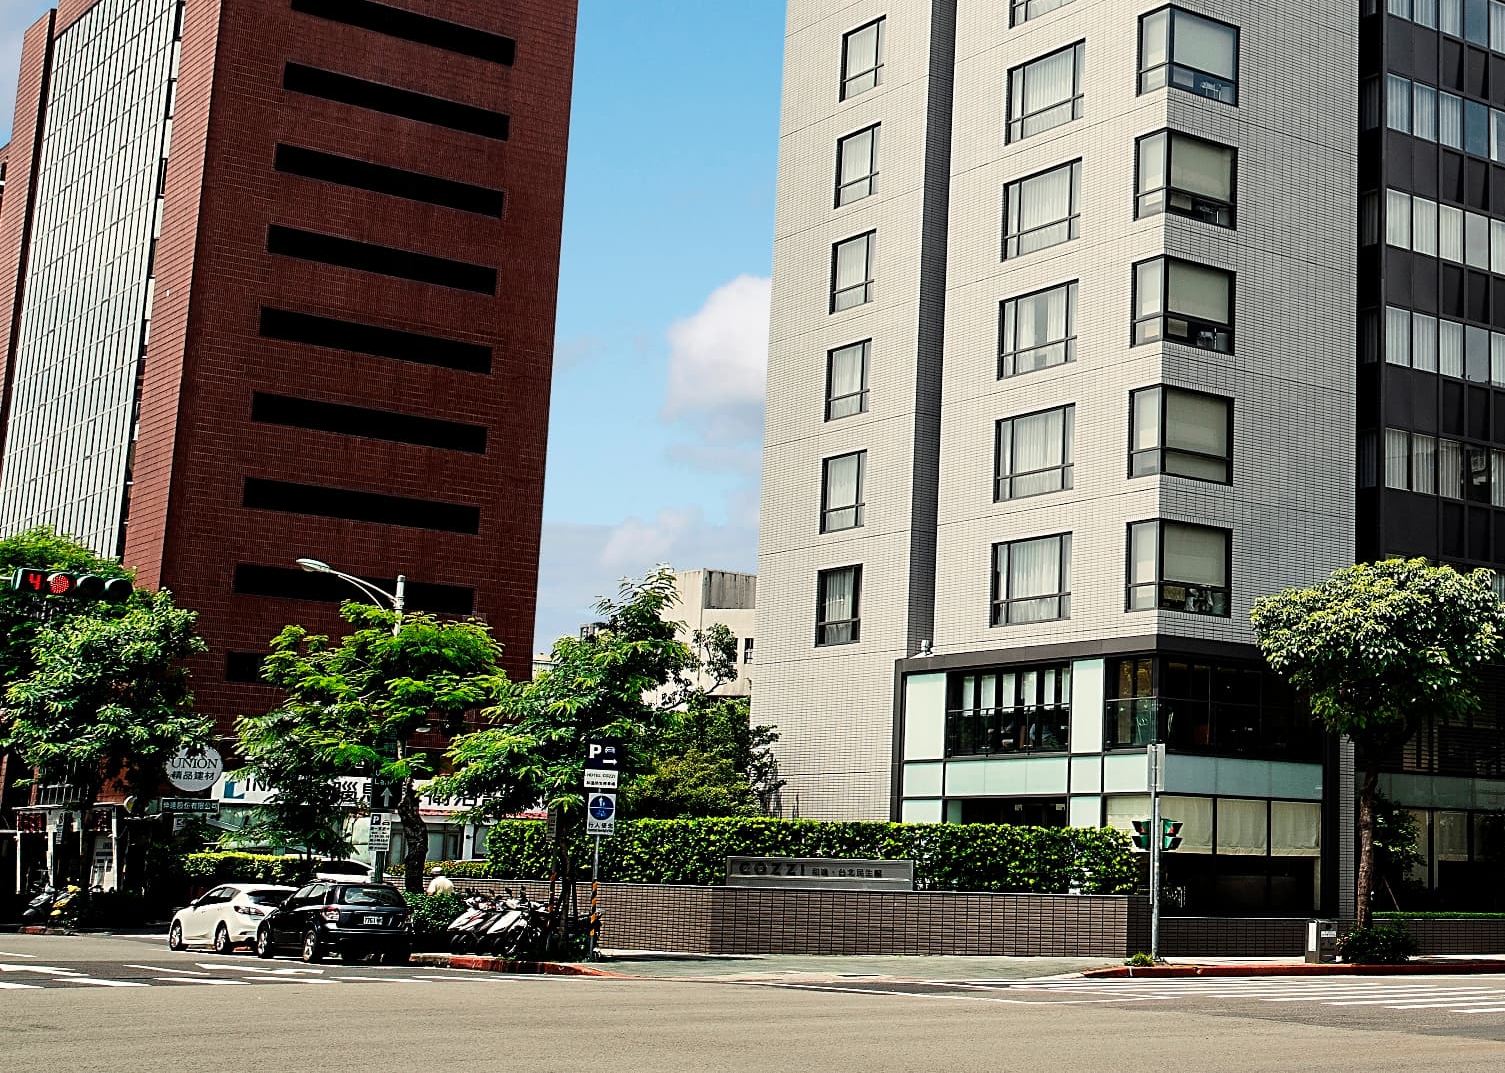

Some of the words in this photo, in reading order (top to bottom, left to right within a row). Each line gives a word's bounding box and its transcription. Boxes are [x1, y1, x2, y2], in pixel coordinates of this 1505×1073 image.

[28, 573, 42, 590] 4
[589, 743, 602, 759] P
[171, 757, 219, 769] UNION
[171, 770, 215, 781] 精品建材
[739, 862, 805, 877] COZZI
